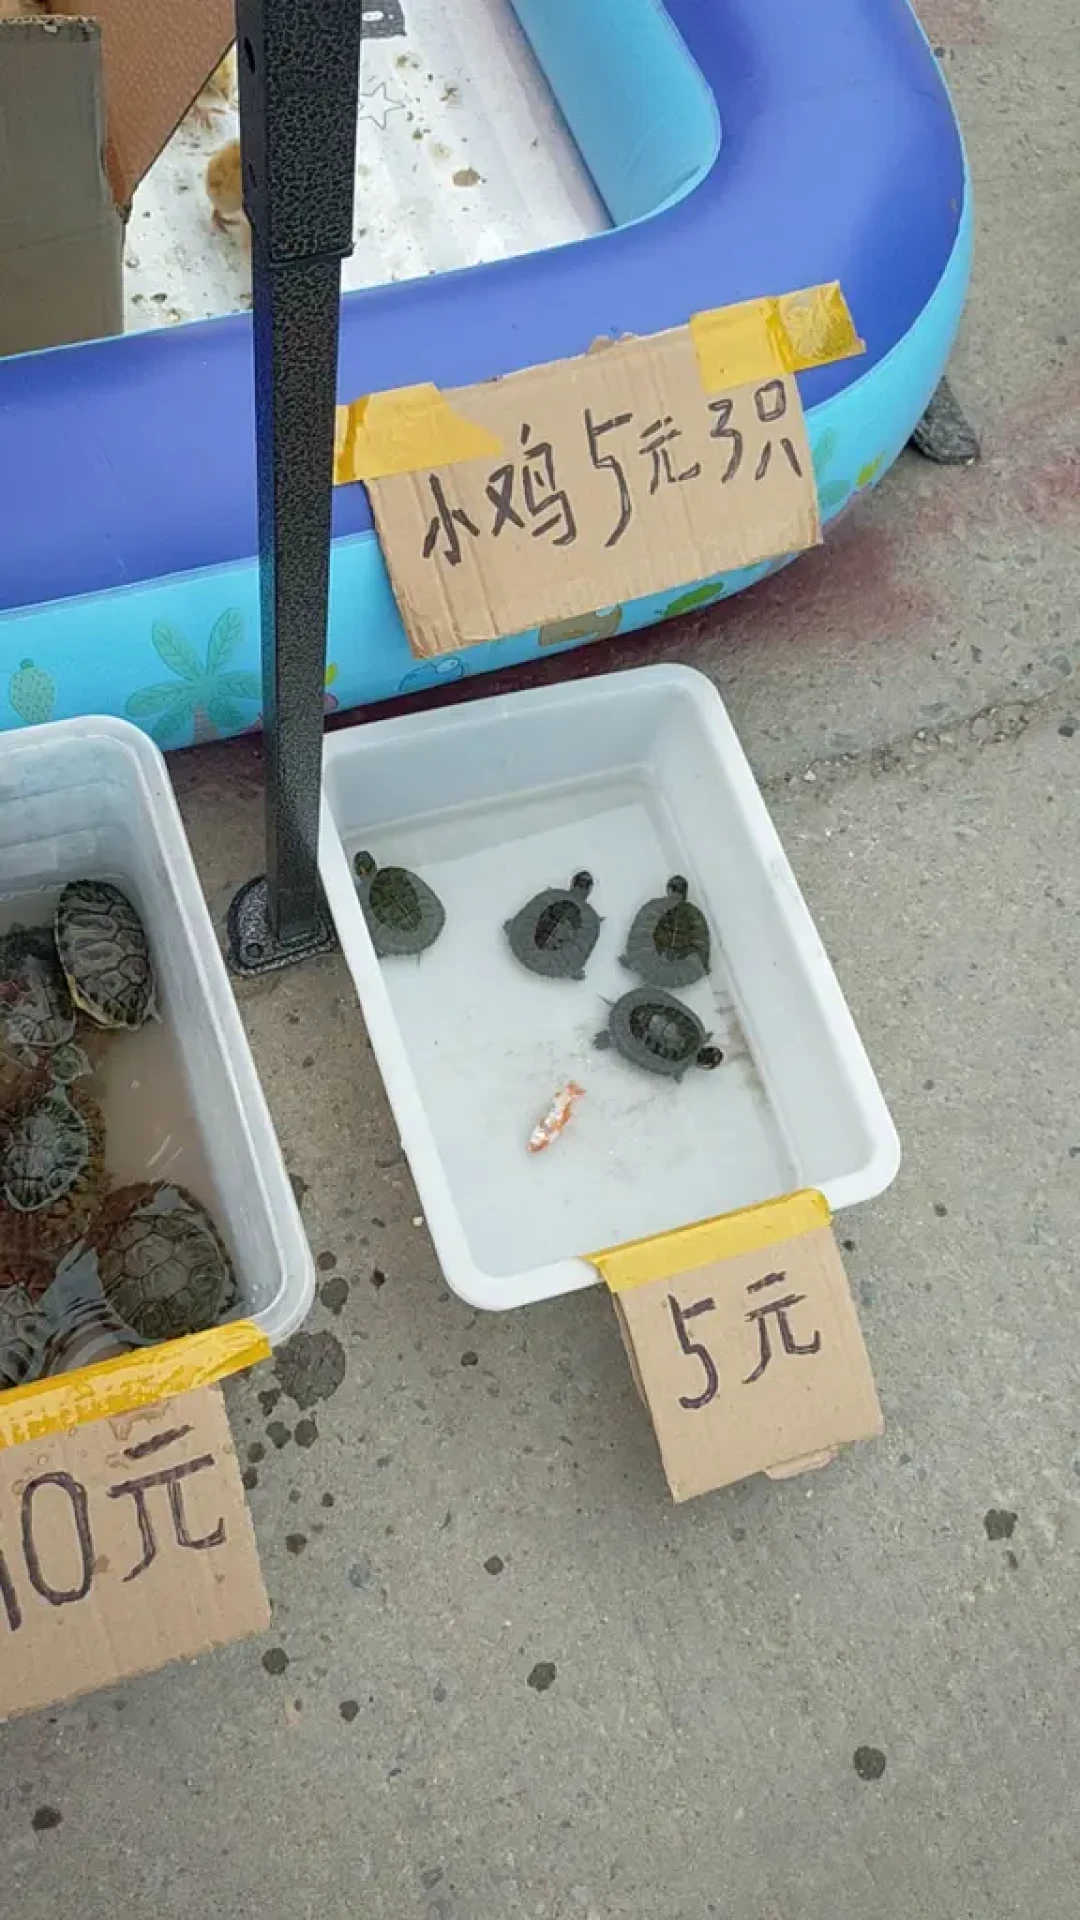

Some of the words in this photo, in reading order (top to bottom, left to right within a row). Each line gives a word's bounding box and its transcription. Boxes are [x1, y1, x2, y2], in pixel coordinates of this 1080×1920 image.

[422, 379, 802, 566] 小鸡5元3只
[667, 1271, 821, 1409] 5元
